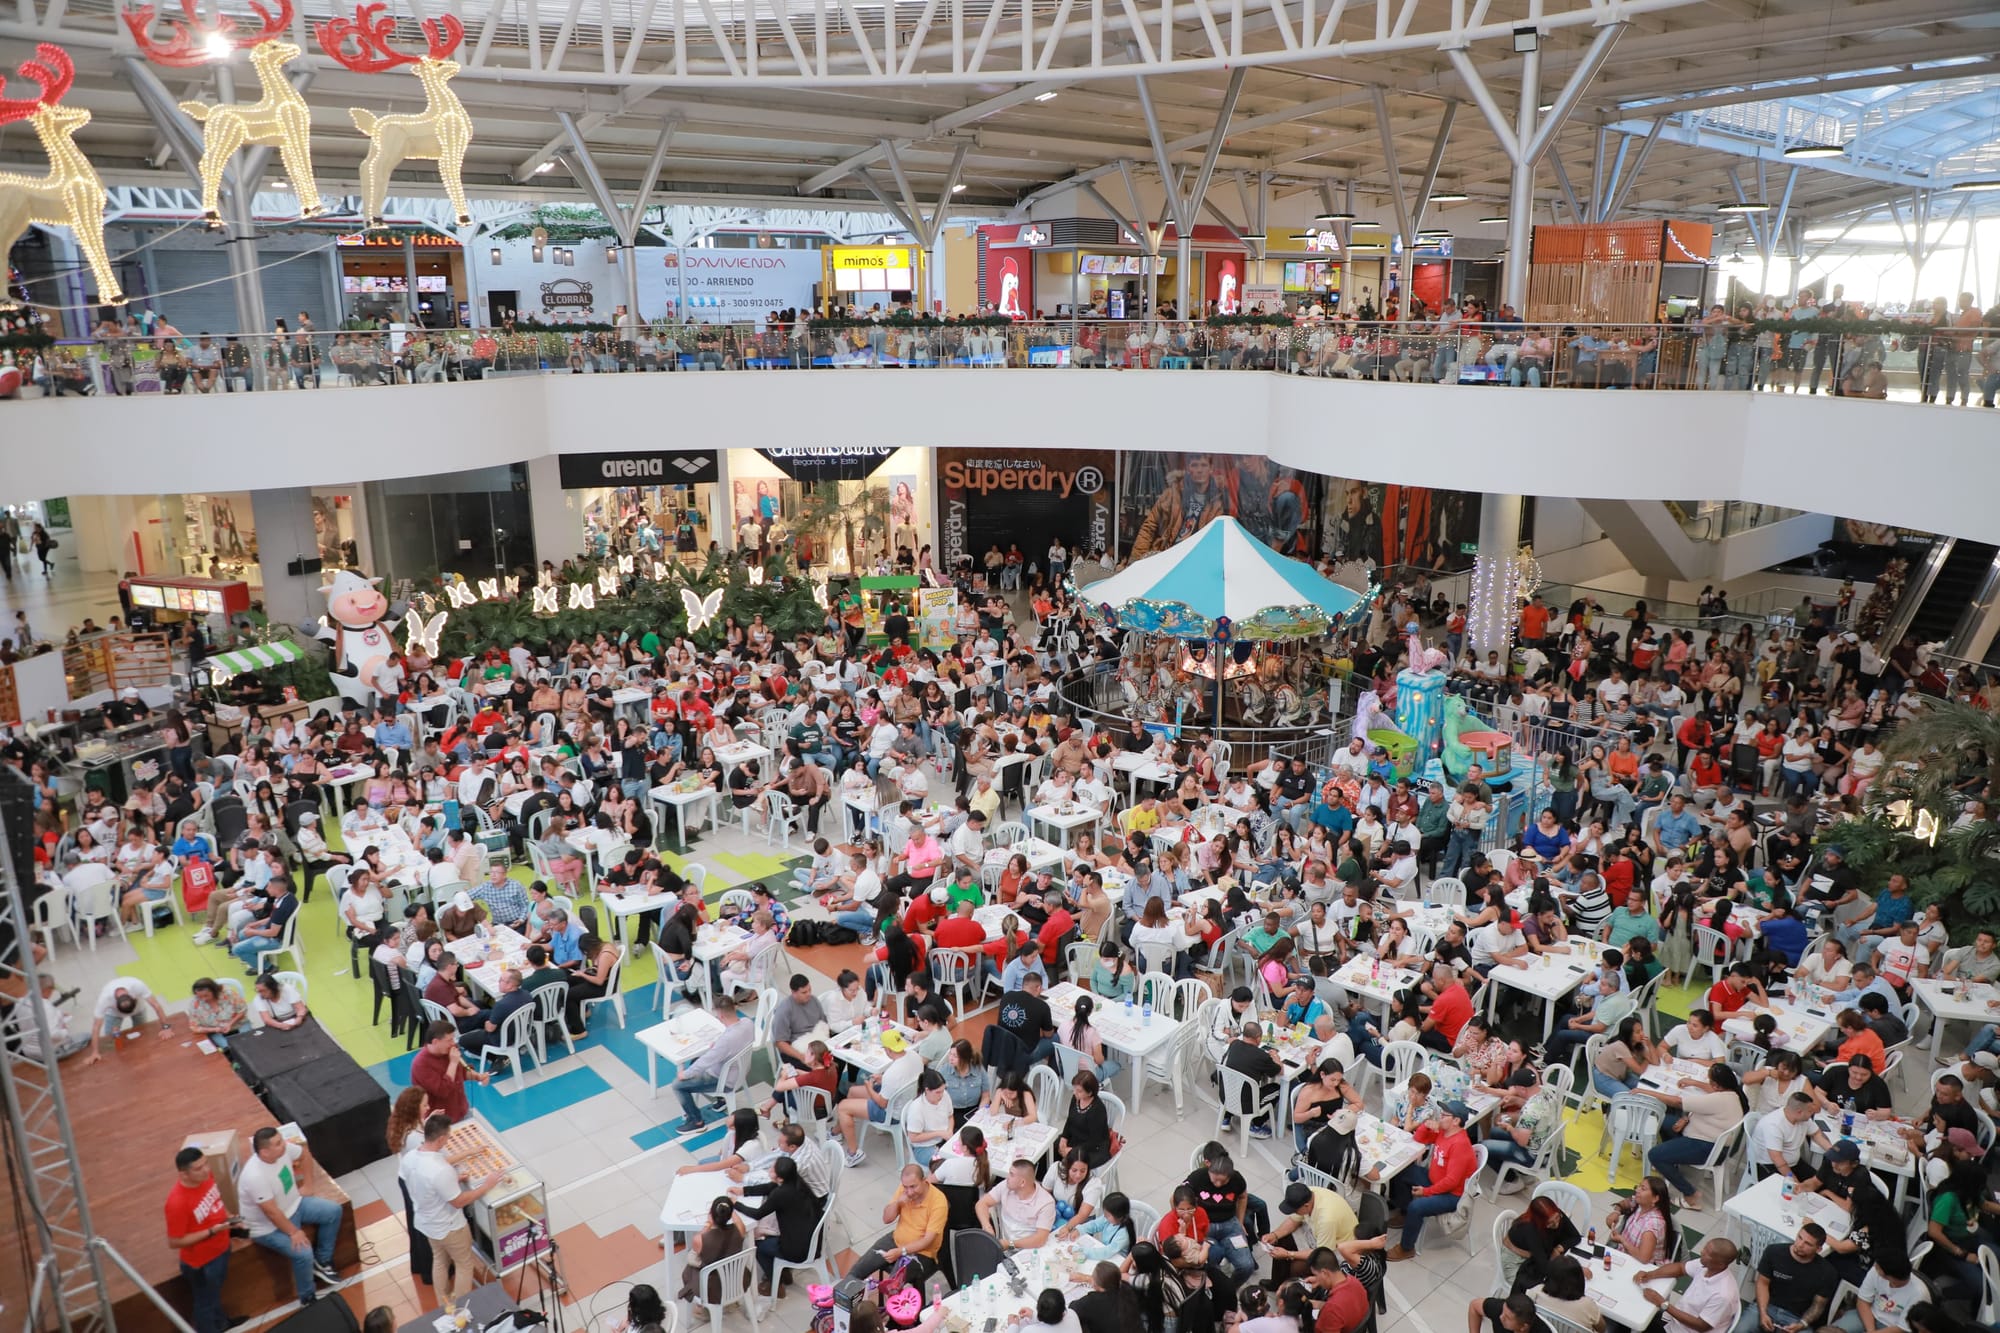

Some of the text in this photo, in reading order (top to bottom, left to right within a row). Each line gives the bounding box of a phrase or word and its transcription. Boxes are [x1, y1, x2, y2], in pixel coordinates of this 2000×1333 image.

[686, 257, 786, 269] DAVIVIENDA
[664, 277, 699, 287] VEDO
[706, 277, 754, 287] ARRIENDO
[545, 295, 590, 305] EL CORRAL
[733, 298, 749, 308] 300
[749, 299, 763, 308] 912
[764, 298, 784, 308] 0475
[601, 458, 663, 478] arena
[925, 589, 953, 600] MANGO
[932, 598, 948, 607] POP
